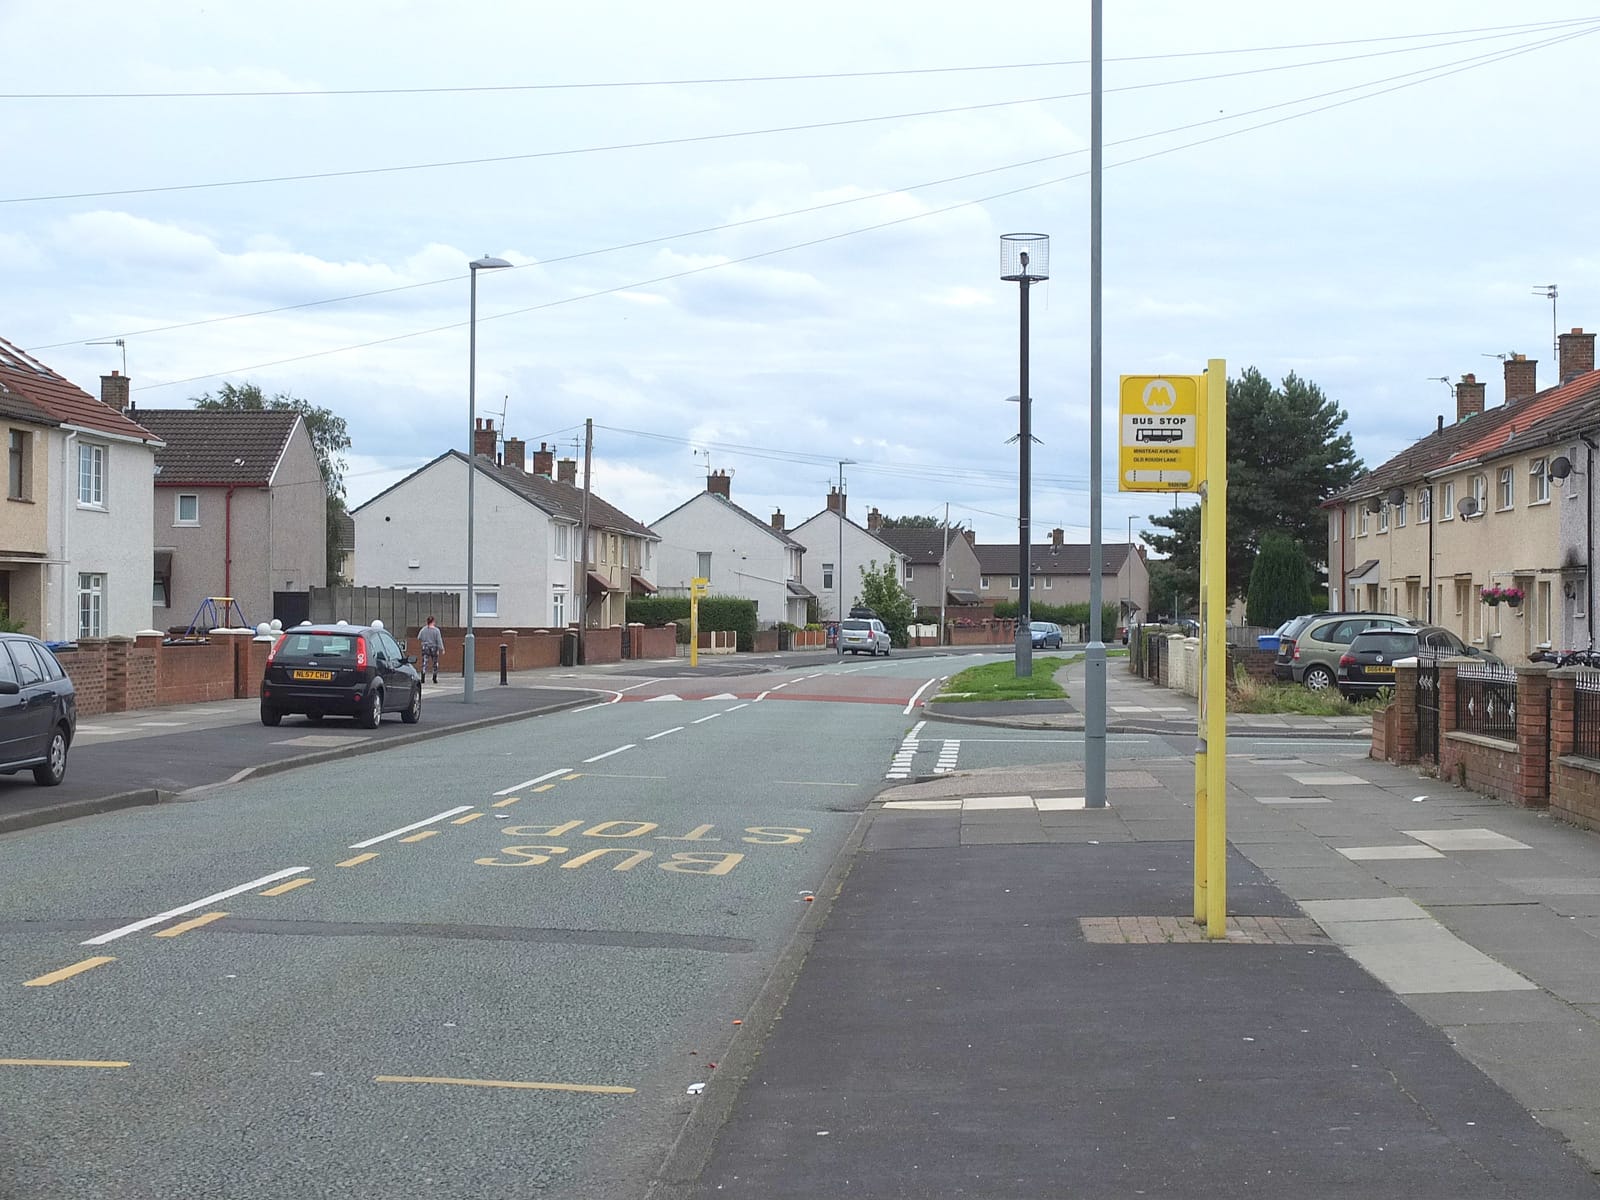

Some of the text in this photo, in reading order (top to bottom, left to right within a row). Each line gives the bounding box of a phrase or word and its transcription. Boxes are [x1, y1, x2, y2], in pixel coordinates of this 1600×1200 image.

[1132, 417, 1187, 425] BUS STOP
[500, 820, 812, 845] STOP
[473, 845, 745, 876] BUS
